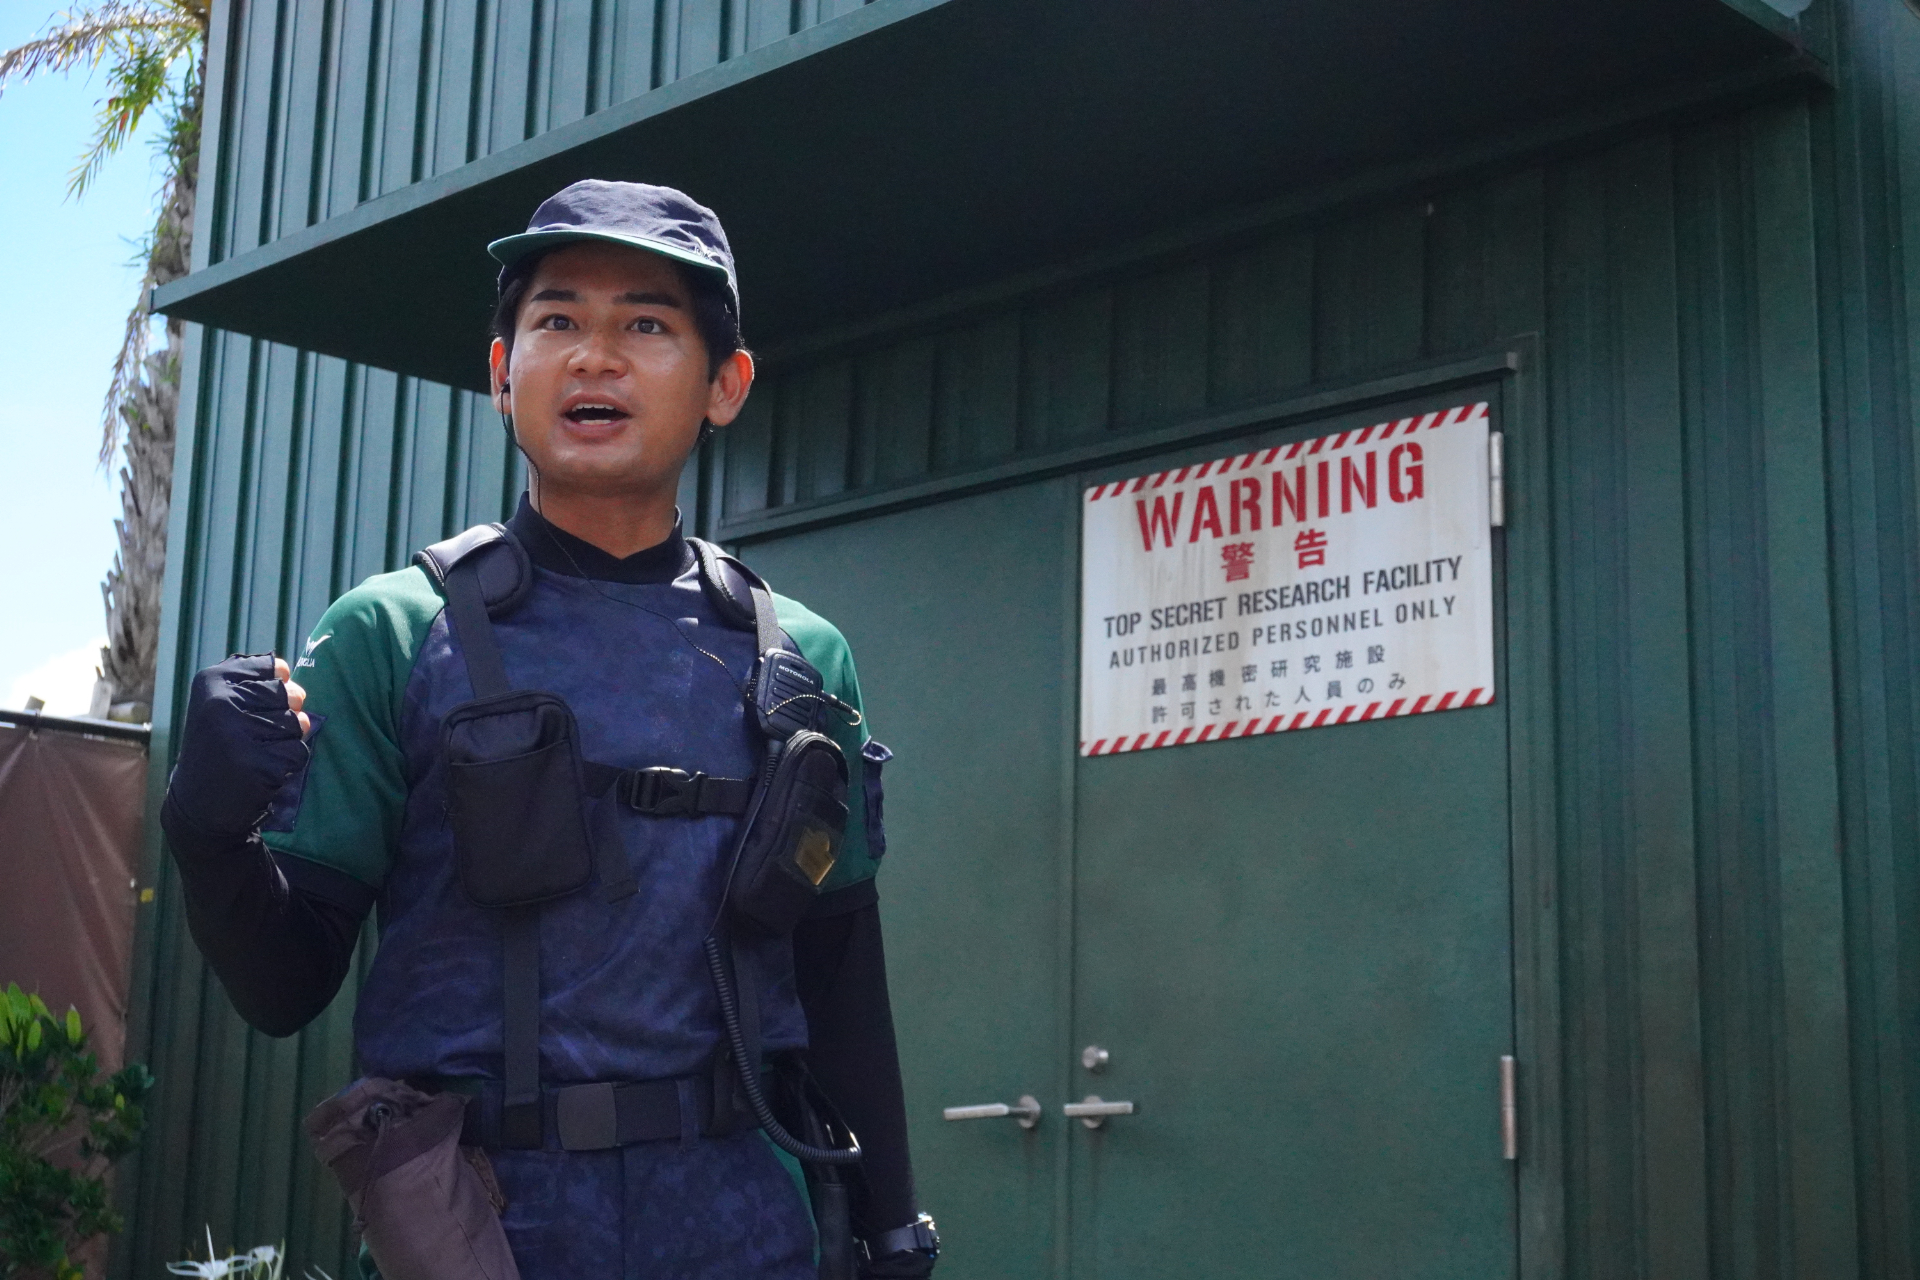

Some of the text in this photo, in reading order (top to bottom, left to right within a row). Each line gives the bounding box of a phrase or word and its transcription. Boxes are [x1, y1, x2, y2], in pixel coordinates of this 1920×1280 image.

[1136, 441, 1425, 552] WARNING
[1220, 528, 1329, 583] 警告
[1103, 555, 1463, 639] TOP SECRET RESEARCH FACILITY
[1109, 595, 1456, 669] AUTHORIZED PERSONNEL ONLY
[778, 664, 814, 685] MOTOROLA
[1151, 645, 1386, 696] 最高機密研究施設
[1151, 673, 1407, 724] 許可された人員のみ
